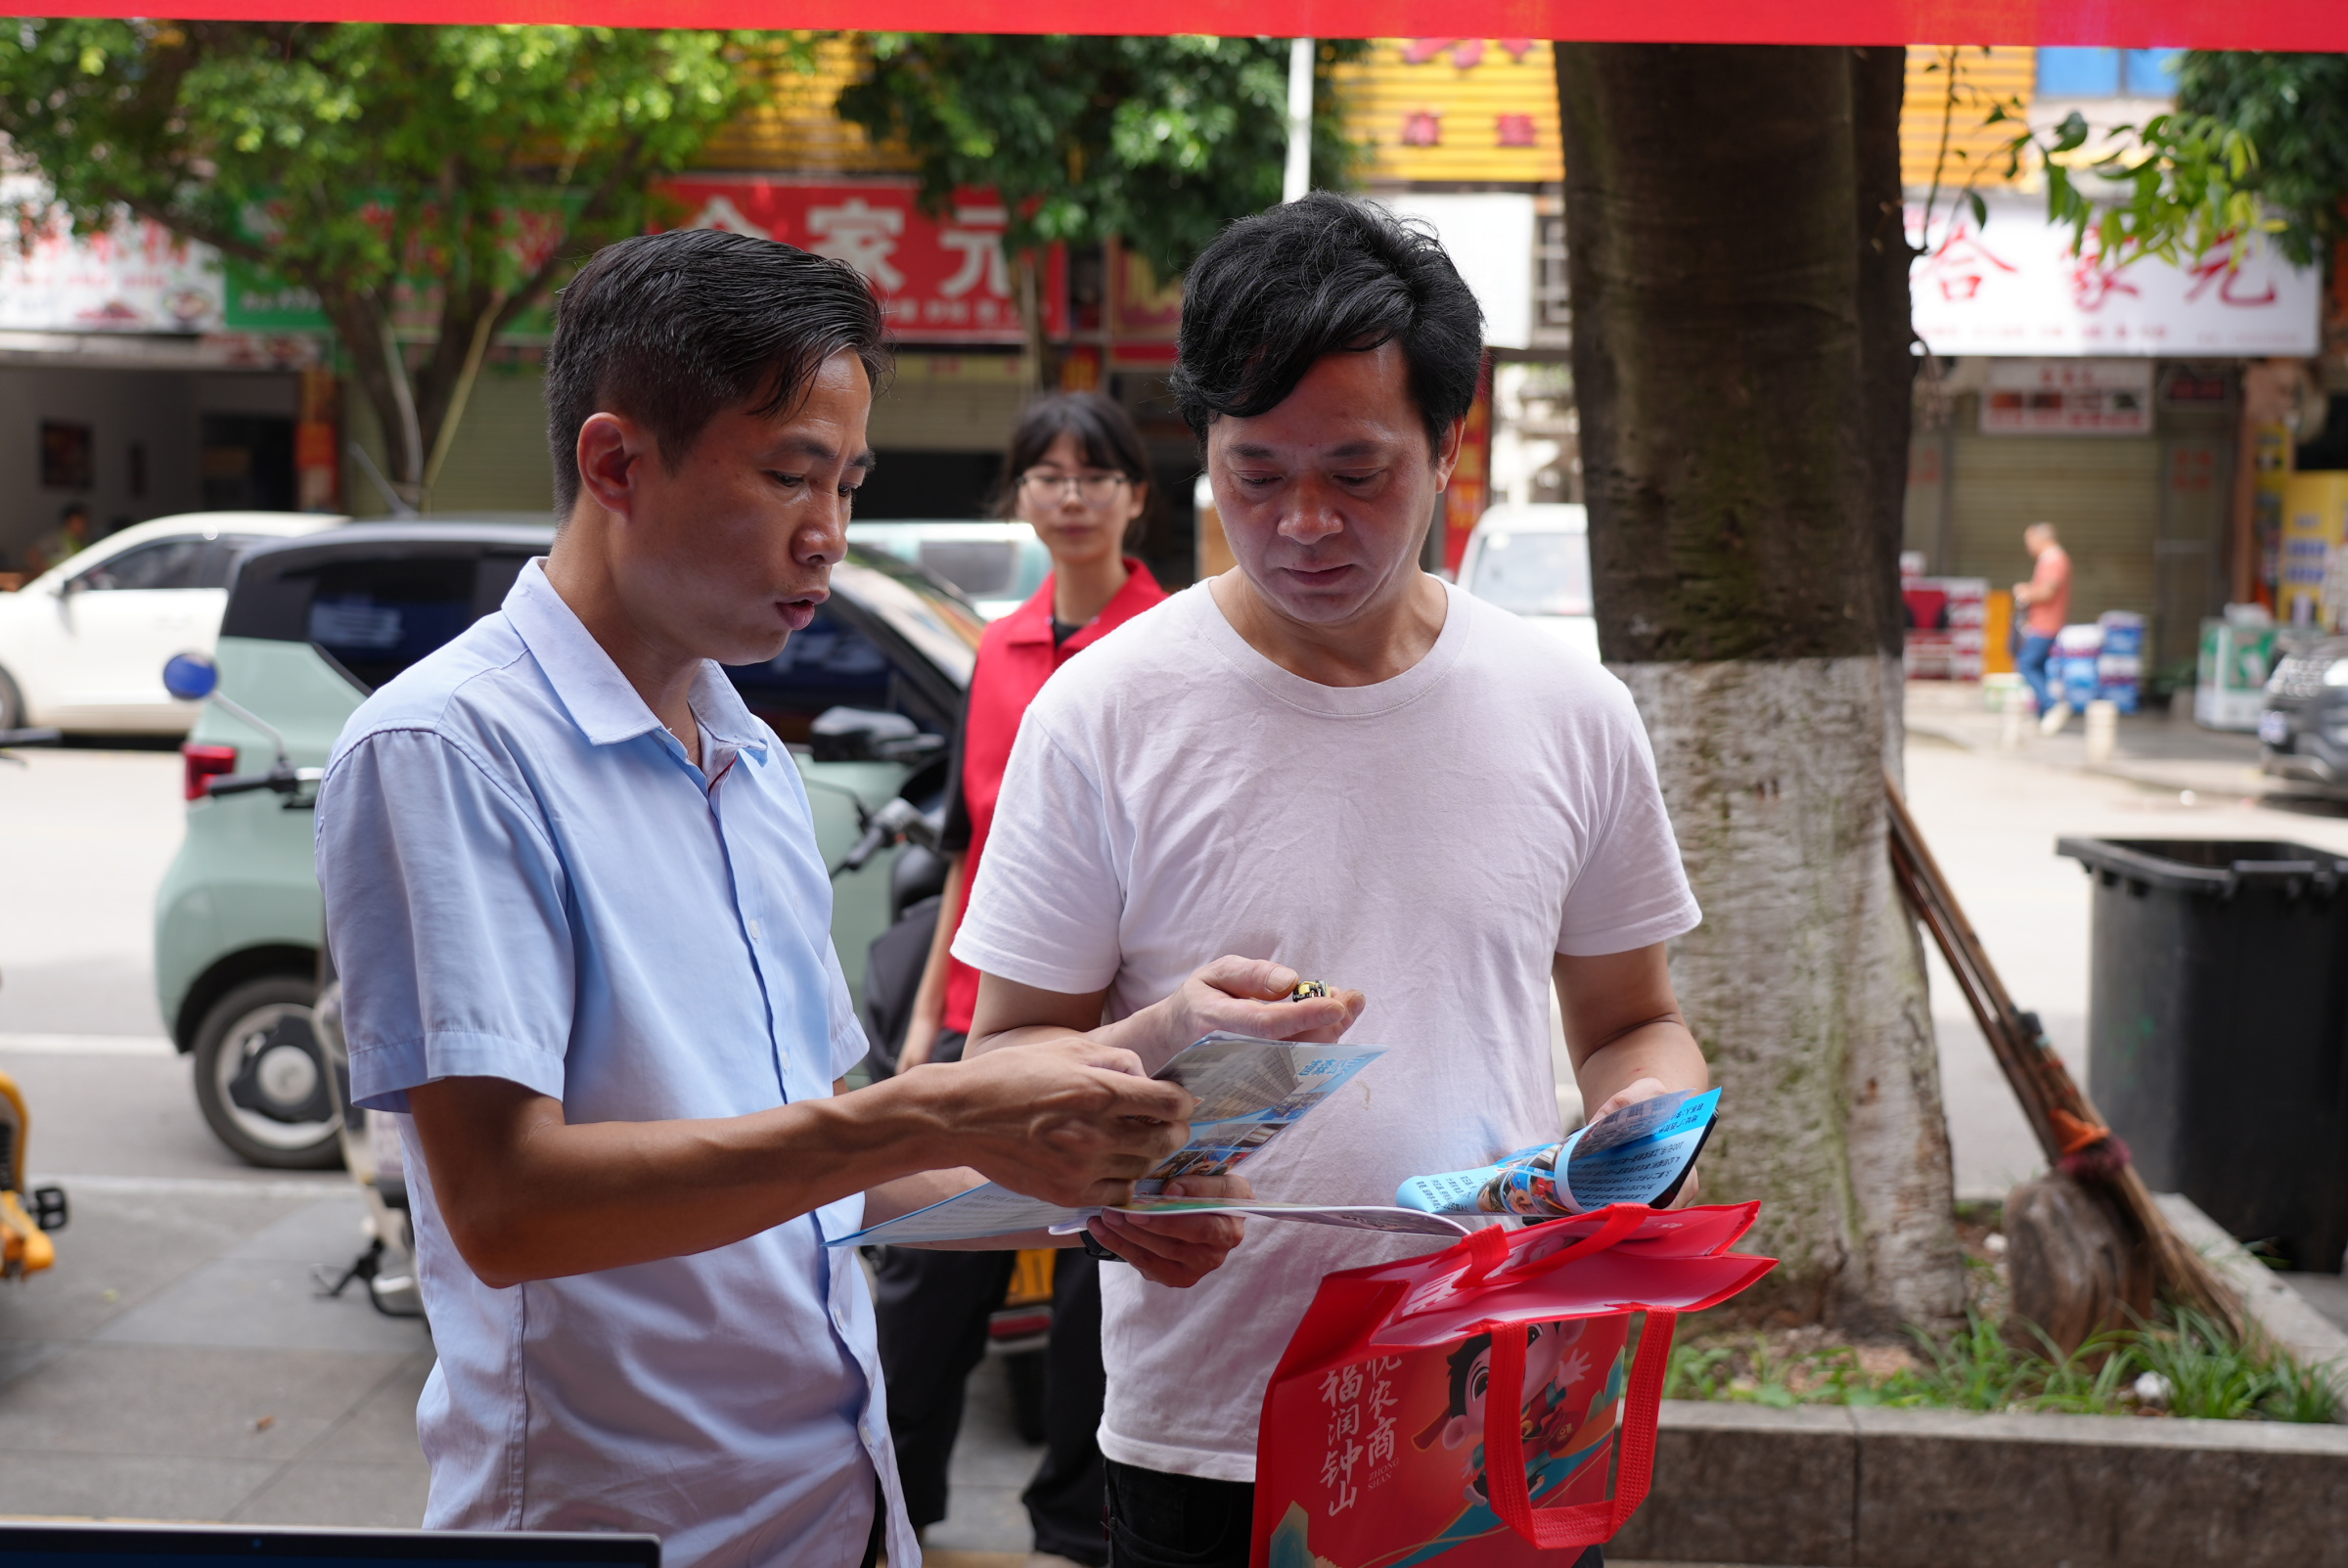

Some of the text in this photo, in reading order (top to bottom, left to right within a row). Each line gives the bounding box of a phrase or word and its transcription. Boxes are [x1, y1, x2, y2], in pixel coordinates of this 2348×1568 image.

[1319, 1364, 1364, 1516] 福润钟山
[1368, 1472, 1393, 1492] SHAN
[1369, 1457, 1400, 1482] ZHONG
